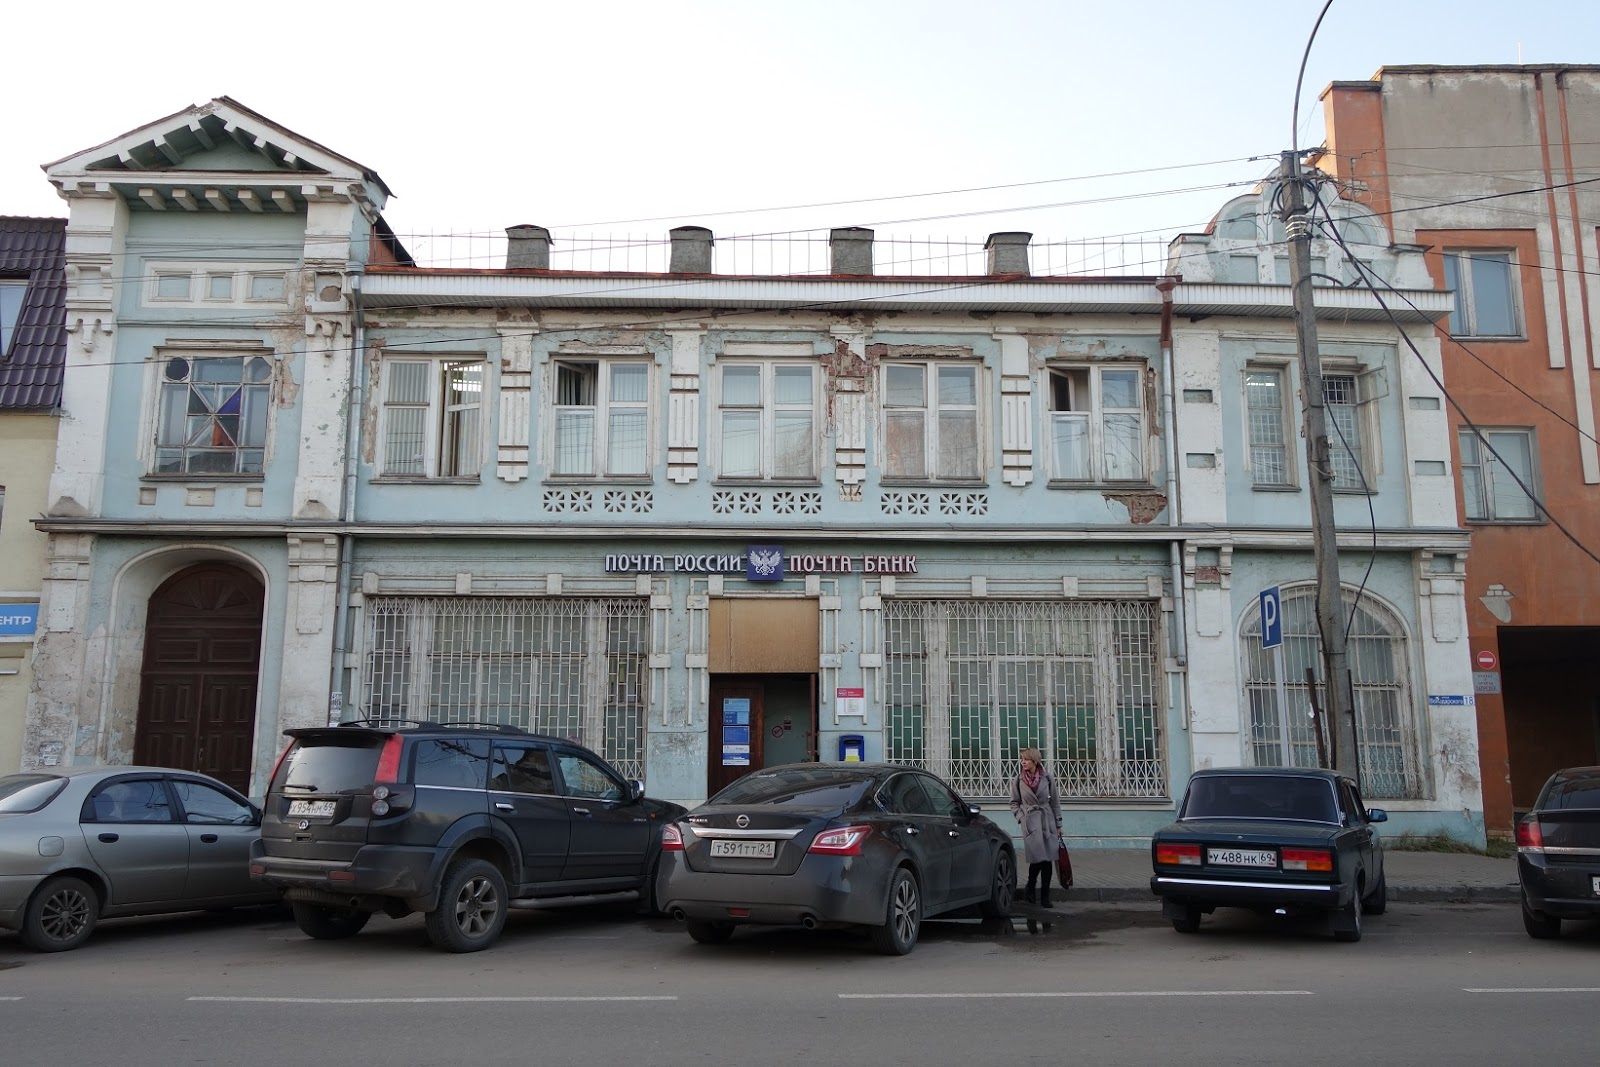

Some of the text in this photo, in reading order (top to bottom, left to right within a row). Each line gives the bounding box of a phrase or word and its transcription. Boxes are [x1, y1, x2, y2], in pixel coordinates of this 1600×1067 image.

[605, 554, 741, 572] ПОЧТА РОССИИ
[789, 555, 919, 574] ПОЧТА БАНК
[1464, 696, 1473, 706] 18
[759, 843, 771, 853] 21
[1260, 852, 1272, 862] 69
